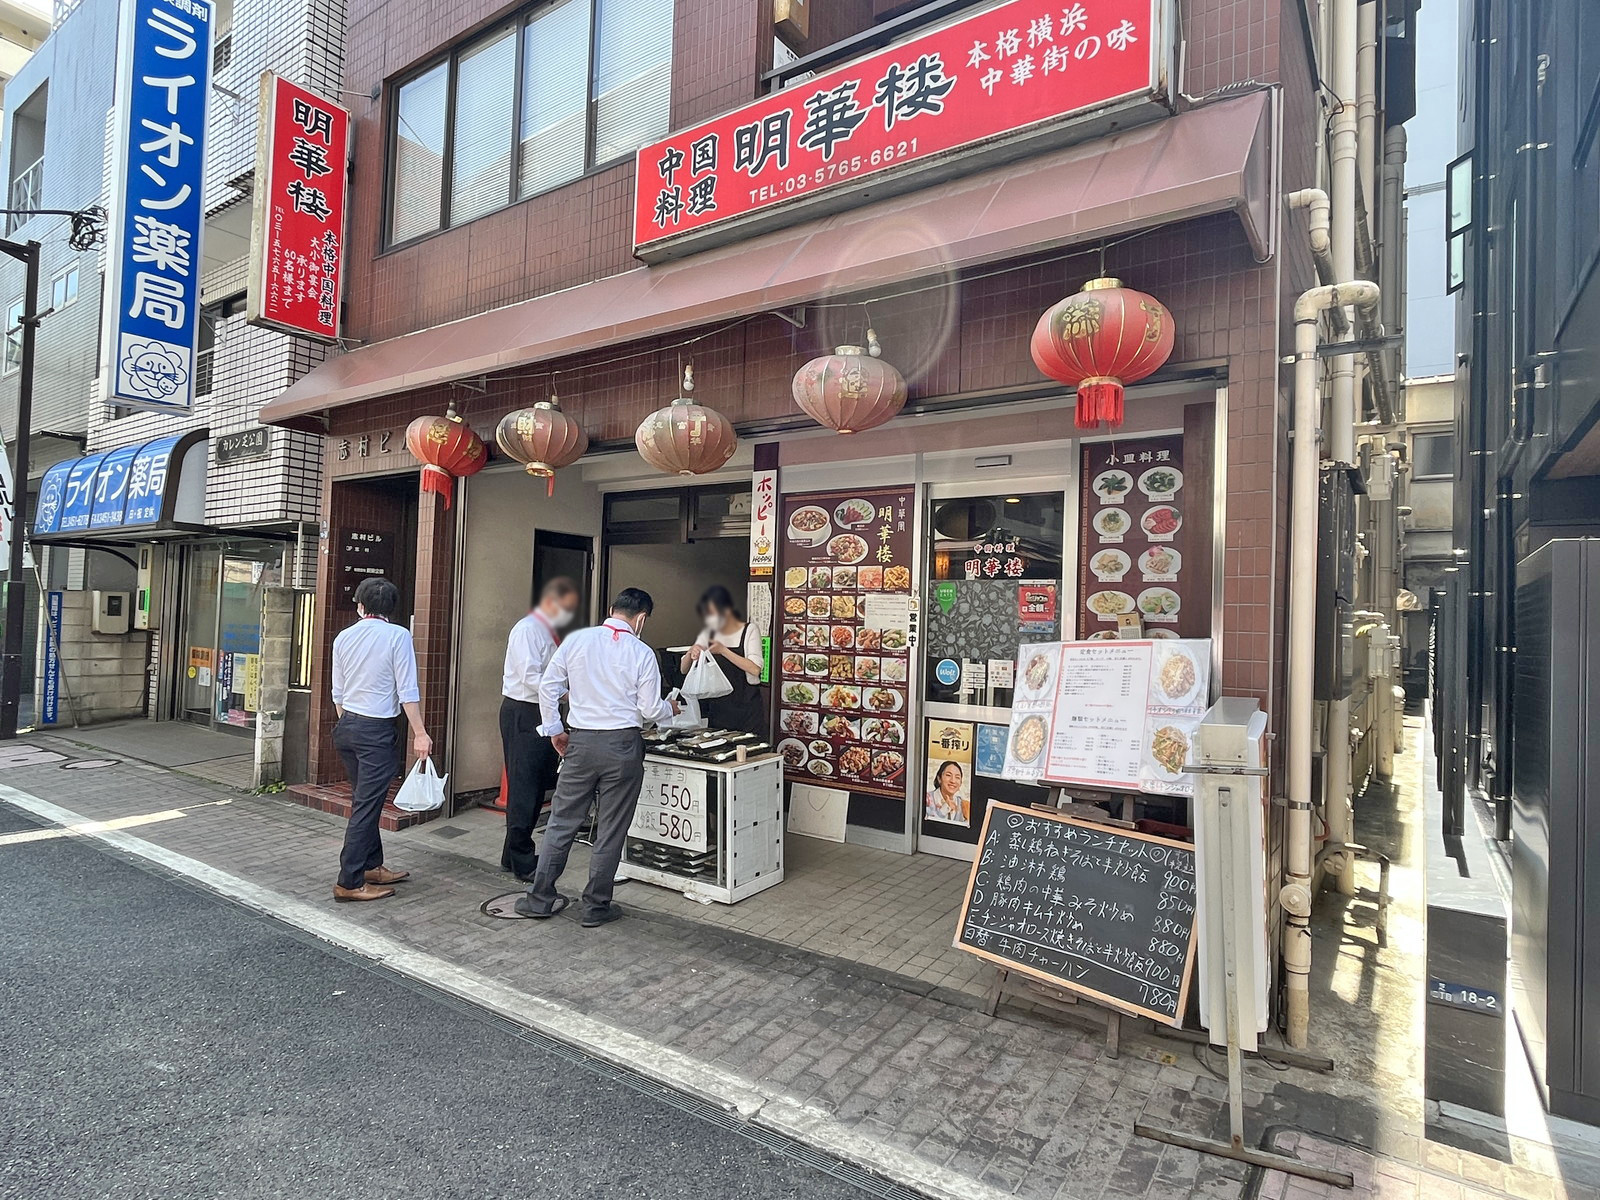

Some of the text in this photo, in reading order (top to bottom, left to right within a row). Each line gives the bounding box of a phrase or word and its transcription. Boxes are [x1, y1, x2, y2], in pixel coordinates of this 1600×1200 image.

[163, 0, 208, 22] 調剤
[965, 3, 1088, 69] 本格横浜
[979, 19, 1138, 96] 中華街の味
[733, 53, 957, 177] 明華楼
[129, 8, 198, 330] ライオン薬局
[287, 98, 334, 223] 明華楼
[657, 133, 719, 187] 中国
[653, 175, 718, 228] 料理
[295, 254, 308, 303] 承ります
[318, 229, 339, 328] 本格中国料理
[67, 453, 169, 508] ライオン薬局
[1105, 450, 1171, 466] 小皿料理
[757, 475, 773, 536] ホッピー
[876, 505, 894, 563] 明華楼
[964, 557, 1024, 578] 明華楼
[908, 612, 918, 647] 営業中
[931, 738, 970, 751] 一番搾り
[990, 892, 1084, 932] 豚肉キムチ炒め
[996, 873, 1135, 923] 鶏肉の中華みそ炒め
[999, 937, 1090, 979] 牛肉チャーハン
[1461, 990, 1496, 1008] 18-2
